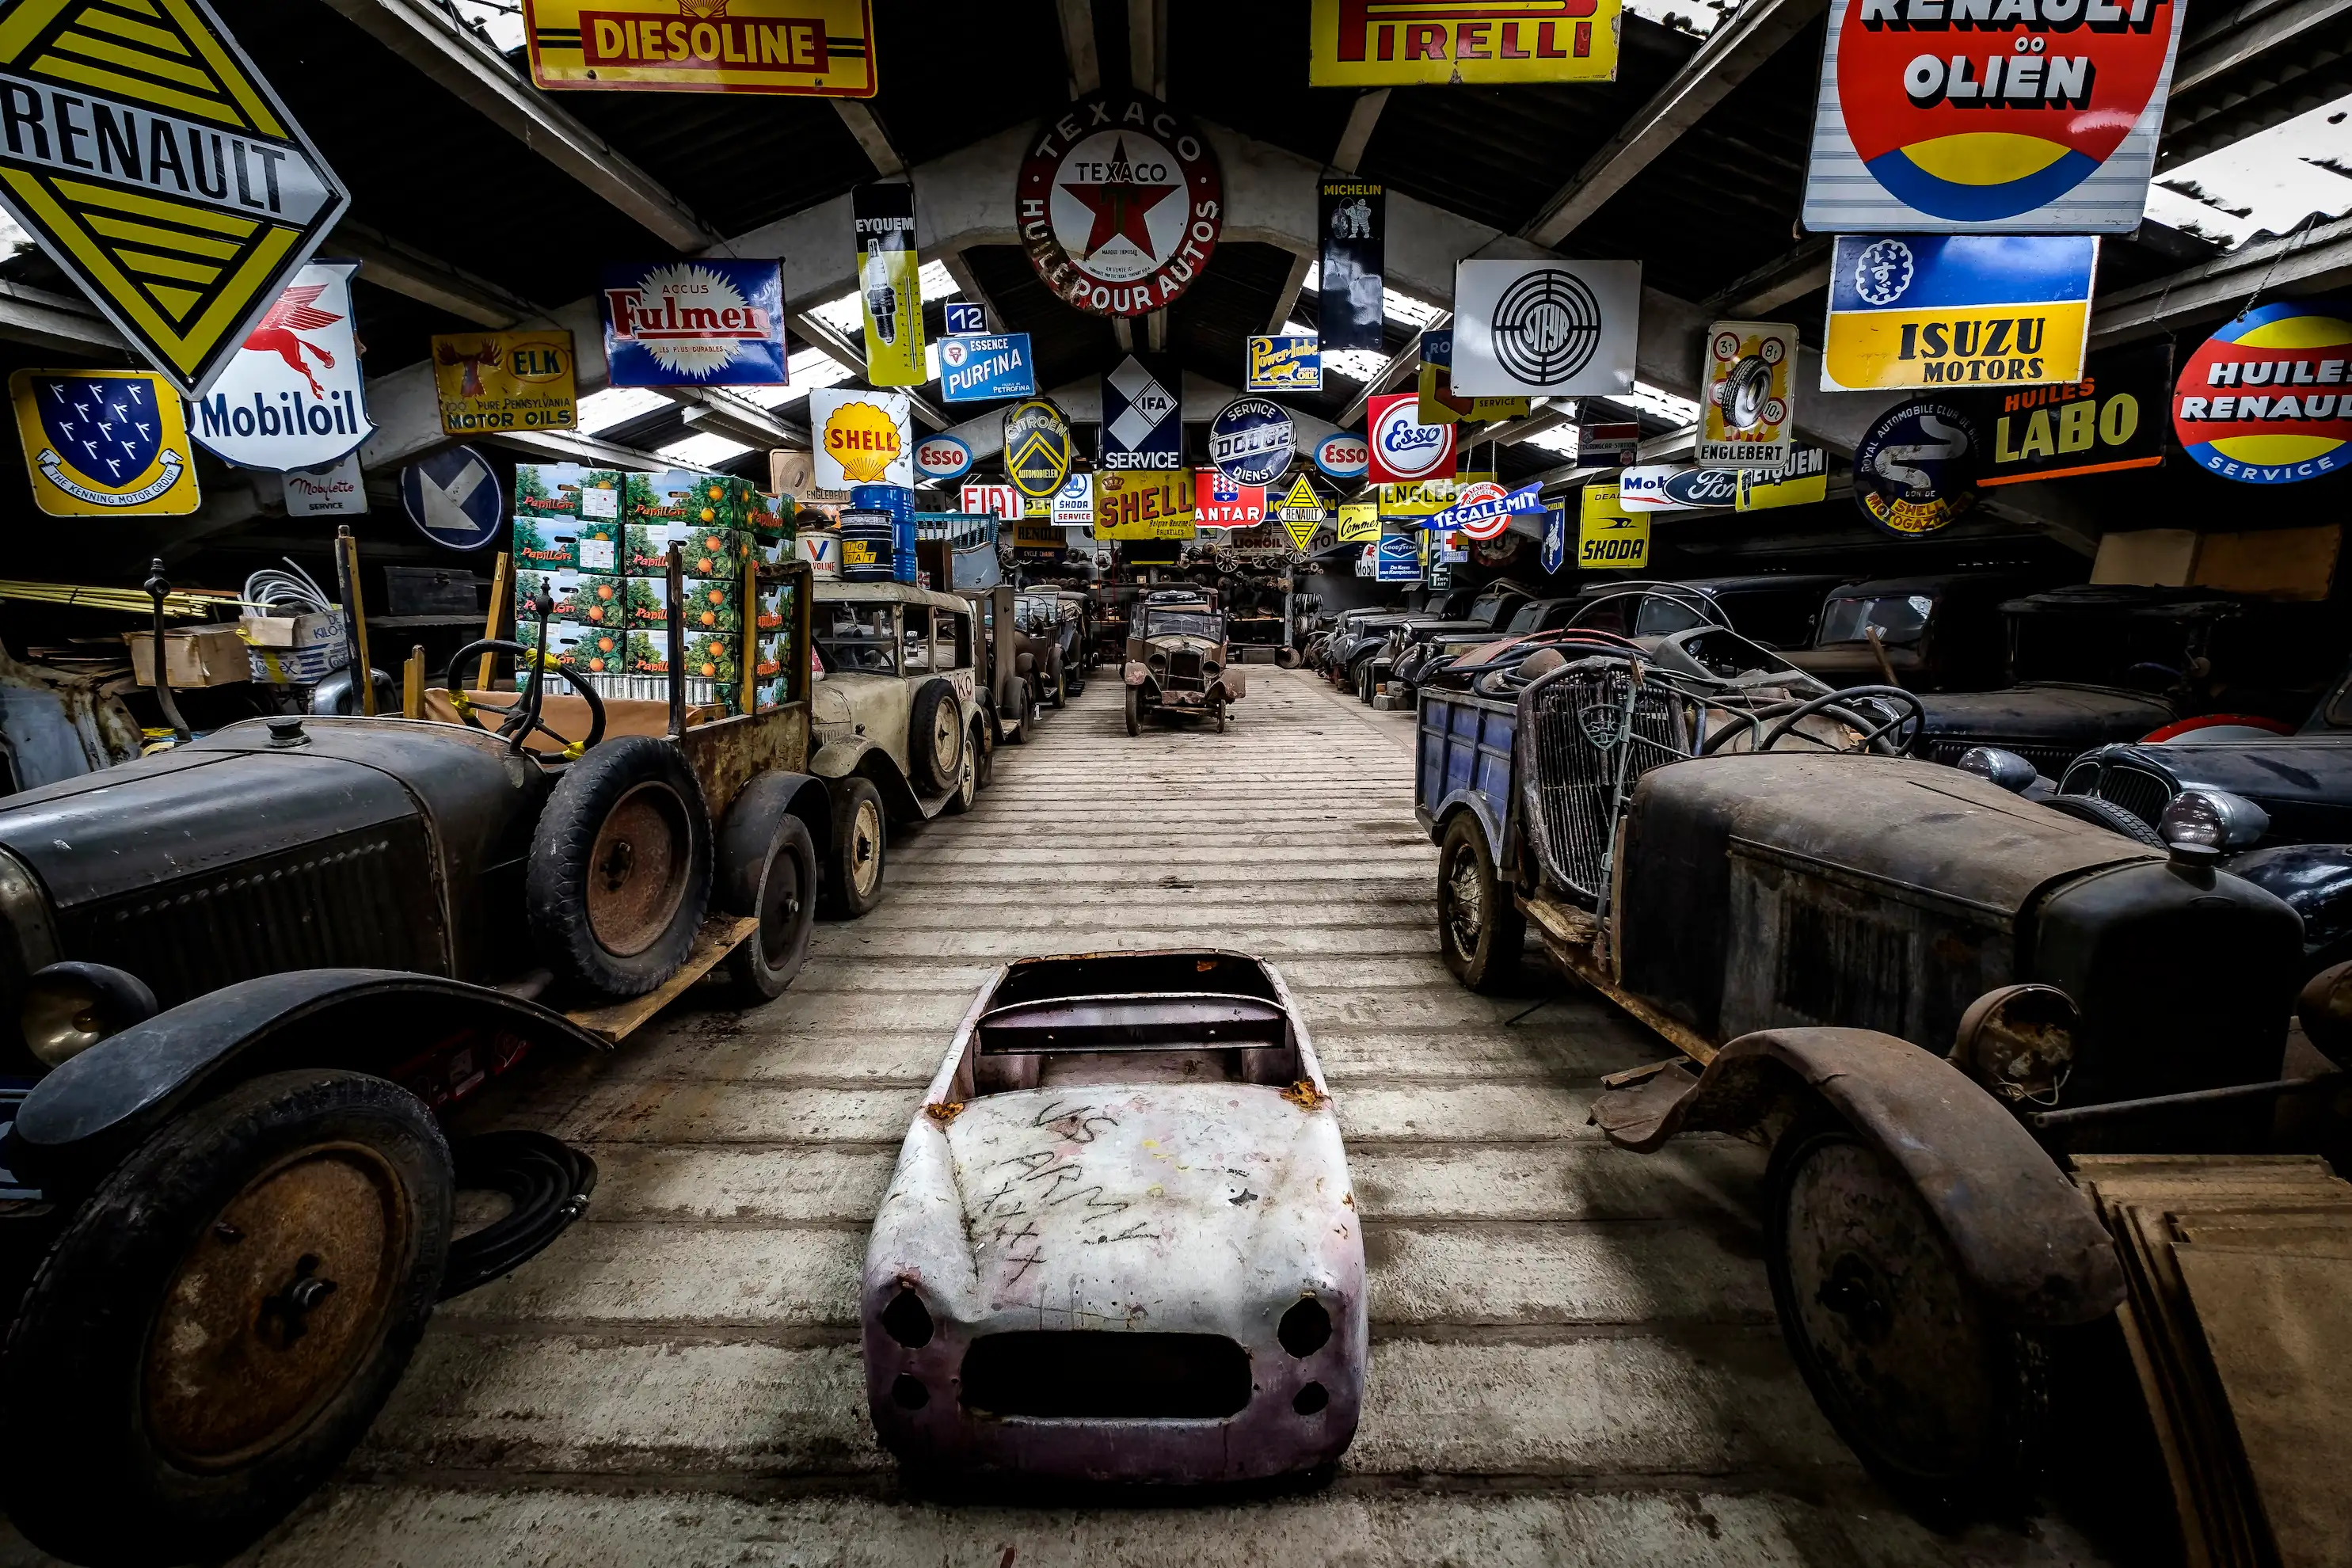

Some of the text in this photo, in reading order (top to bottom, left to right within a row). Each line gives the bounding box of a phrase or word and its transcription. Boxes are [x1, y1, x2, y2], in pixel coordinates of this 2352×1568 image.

[1337, 0, 1598, 62] PIRELLI
[594, 19, 815, 65] DIESOLINE
[1903, 36, 2095, 108] OLIËN
[1035, 101, 1201, 162] TEXACO
[2, 82, 286, 214] RENAULT
[1074, 162, 1167, 183] TEXACO
[1324, 185, 1382, 196] MICHELIN
[855, 217, 915, 234] EYQUEM
[1071, 278, 1153, 312] POUR
[1159, 200, 1220, 299] AUTOS
[662, 284, 710, 294] ACCUS
[604, 288, 771, 340] Fulmen
[950, 308, 984, 329] 12
[1523, 303, 1570, 353] STEYR
[970, 338, 1009, 352] ESSENCE
[1720, 341, 1734, 354] 3t
[1898, 318, 2046, 360] ISUZU
[1765, 345, 1778, 359] 8t
[513, 350, 561, 375] ELK
[949, 348, 1023, 394] PURFINA
[1923, 358, 2044, 382] MOTORS
[993, 385, 1030, 394] PETROFINA
[2004, 378, 2095, 413] HUILES
[478, 400, 500, 410] PURE
[504, 398, 571, 409] PENNSYLVANIA
[1141, 397, 1168, 410] IFA
[1227, 402, 1276, 422] SERVICE
[1479, 398, 1516, 408] SERVICE
[1765, 403, 1780, 421] 10t
[200, 394, 359, 437] Mobiloil
[447, 409, 572, 429] MOTOR OILS
[1384, 419, 1441, 452] Esso
[1995, 393, 2139, 463] LABO
[831, 428, 896, 452] SHELL
[1216, 423, 1291, 458] DODGE
[1861, 440, 1879, 473] ROYAL
[1877, 404, 1935, 439] AUTOMOBILE
[1105, 451, 1179, 469] SERVICE
[1701, 444, 1783, 461] ENGLEBERT
[1232, 466, 1274, 481] DIENST
[2208, 456, 2335, 480] SERVICE
[51, 469, 177, 504] THE KENNING MOTOR GROUP
[289, 477, 355, 501] Mobylette
[1468, 484, 1492, 496] STATION
[1687, 470, 1737, 499] For
[523, 497, 576, 509] Papillon
[807, 490, 847, 500] ENGLEBERT
[964, 487, 1017, 518] FIAT
[1060, 499, 1088, 508] ŠKODA
[1099, 481, 1193, 529] SHELL
[1466, 489, 1496, 504] OFFICIELLE
[309, 502, 344, 511] SERVICE
[634, 504, 687, 516] Papillon
[1196, 506, 1261, 522] ANTAR
[1286, 508, 1319, 520] RENAULT
[1895, 500, 1945, 516] SHELL
[752, 507, 784, 528] Papillon
[1018, 527, 1062, 541] RENOLD
[522, 547, 573, 561] Papillon
[1581, 539, 1645, 560] ŠKODA
[1356, 561, 1376, 577] Mobil
[523, 599, 577, 614] Palon
[635, 607, 687, 621] Papill
[636, 660, 687, 672] Papill
